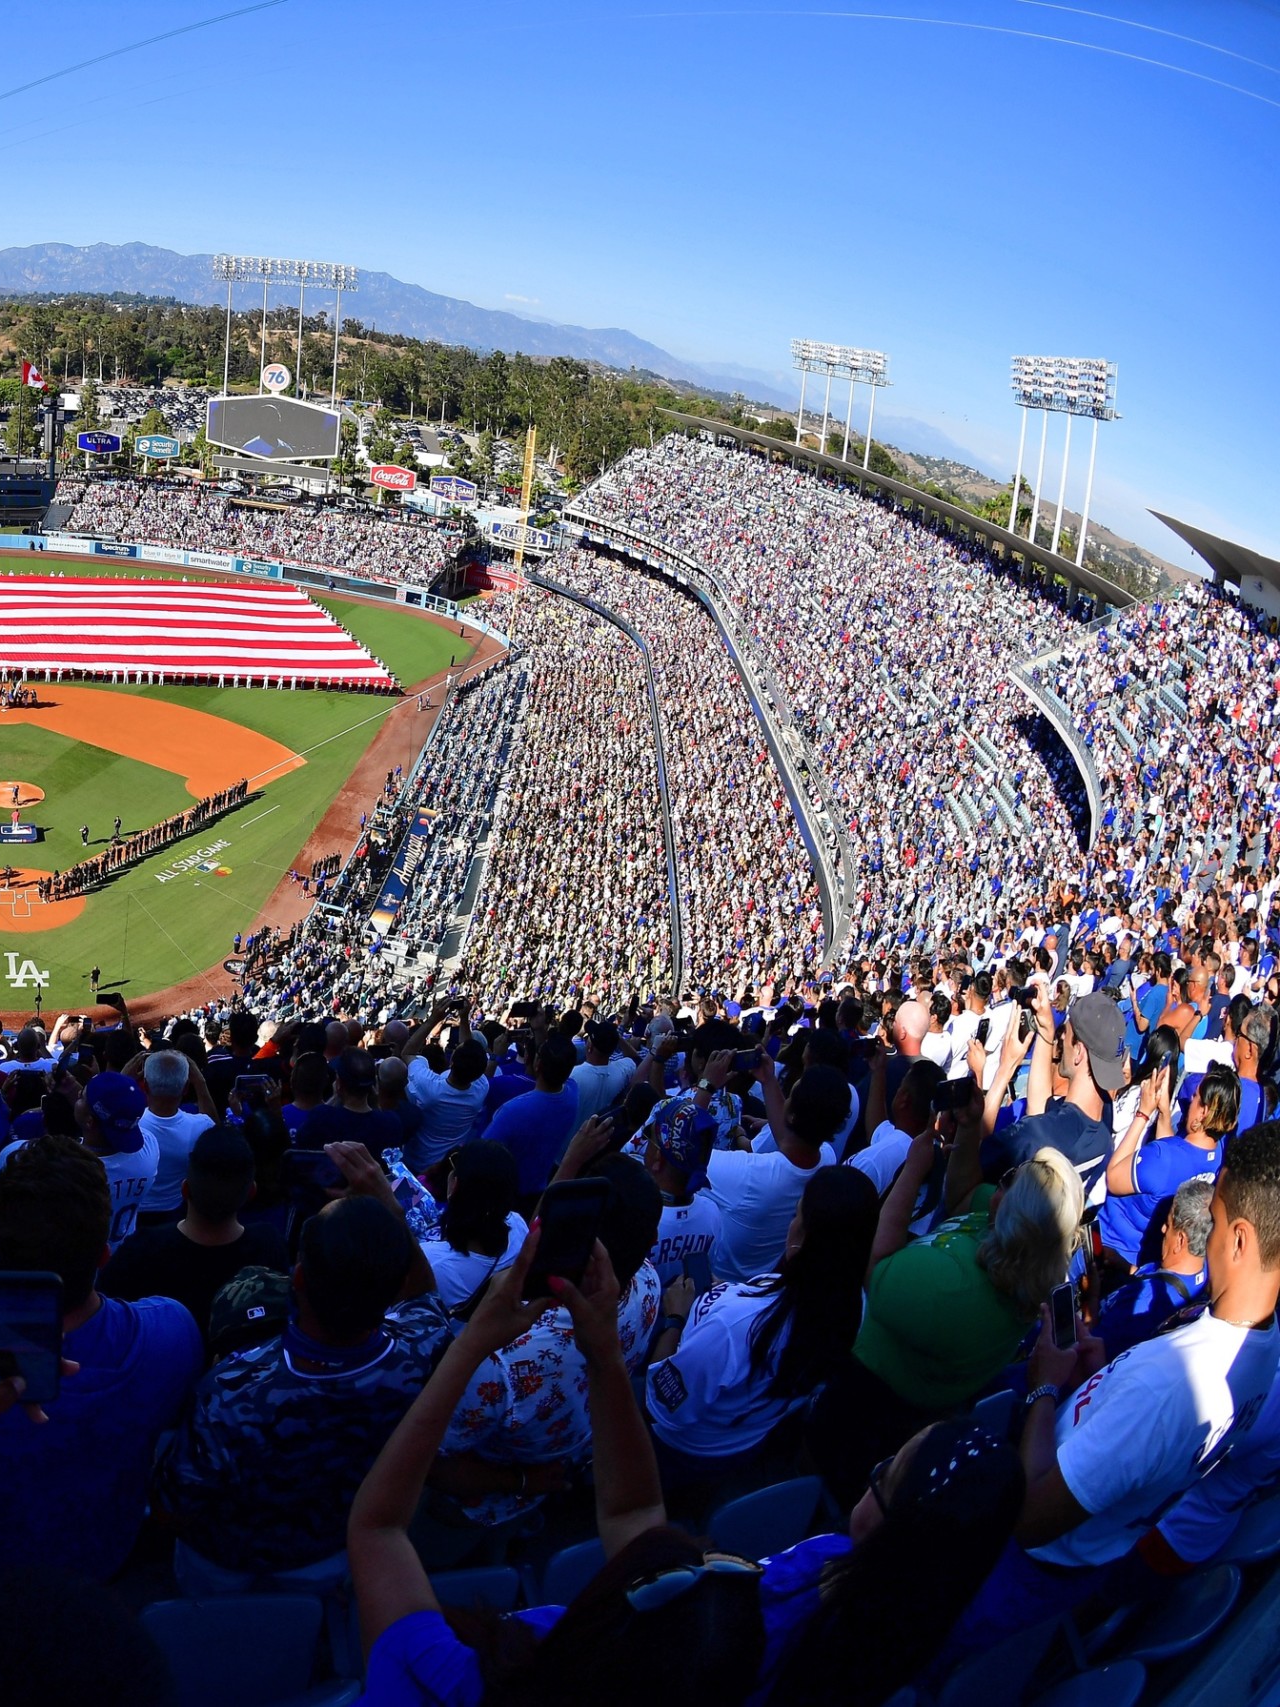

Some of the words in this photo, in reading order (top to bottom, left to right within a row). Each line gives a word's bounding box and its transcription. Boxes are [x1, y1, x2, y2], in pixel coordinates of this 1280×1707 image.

[268, 371, 285, 384] 76
[151, 440, 175, 448] Security
[101, 543, 129, 552] Spectrum
[190, 556, 231, 568] smartwater
[153, 869, 180, 883] ALL
[172, 854, 205, 872] STAR
[196, 839, 232, 858] GAME
[3, 952, 50, 988] LA
[671, 1117, 685, 1149] STAR
[649, 1234, 716, 1268] ERSHAW
